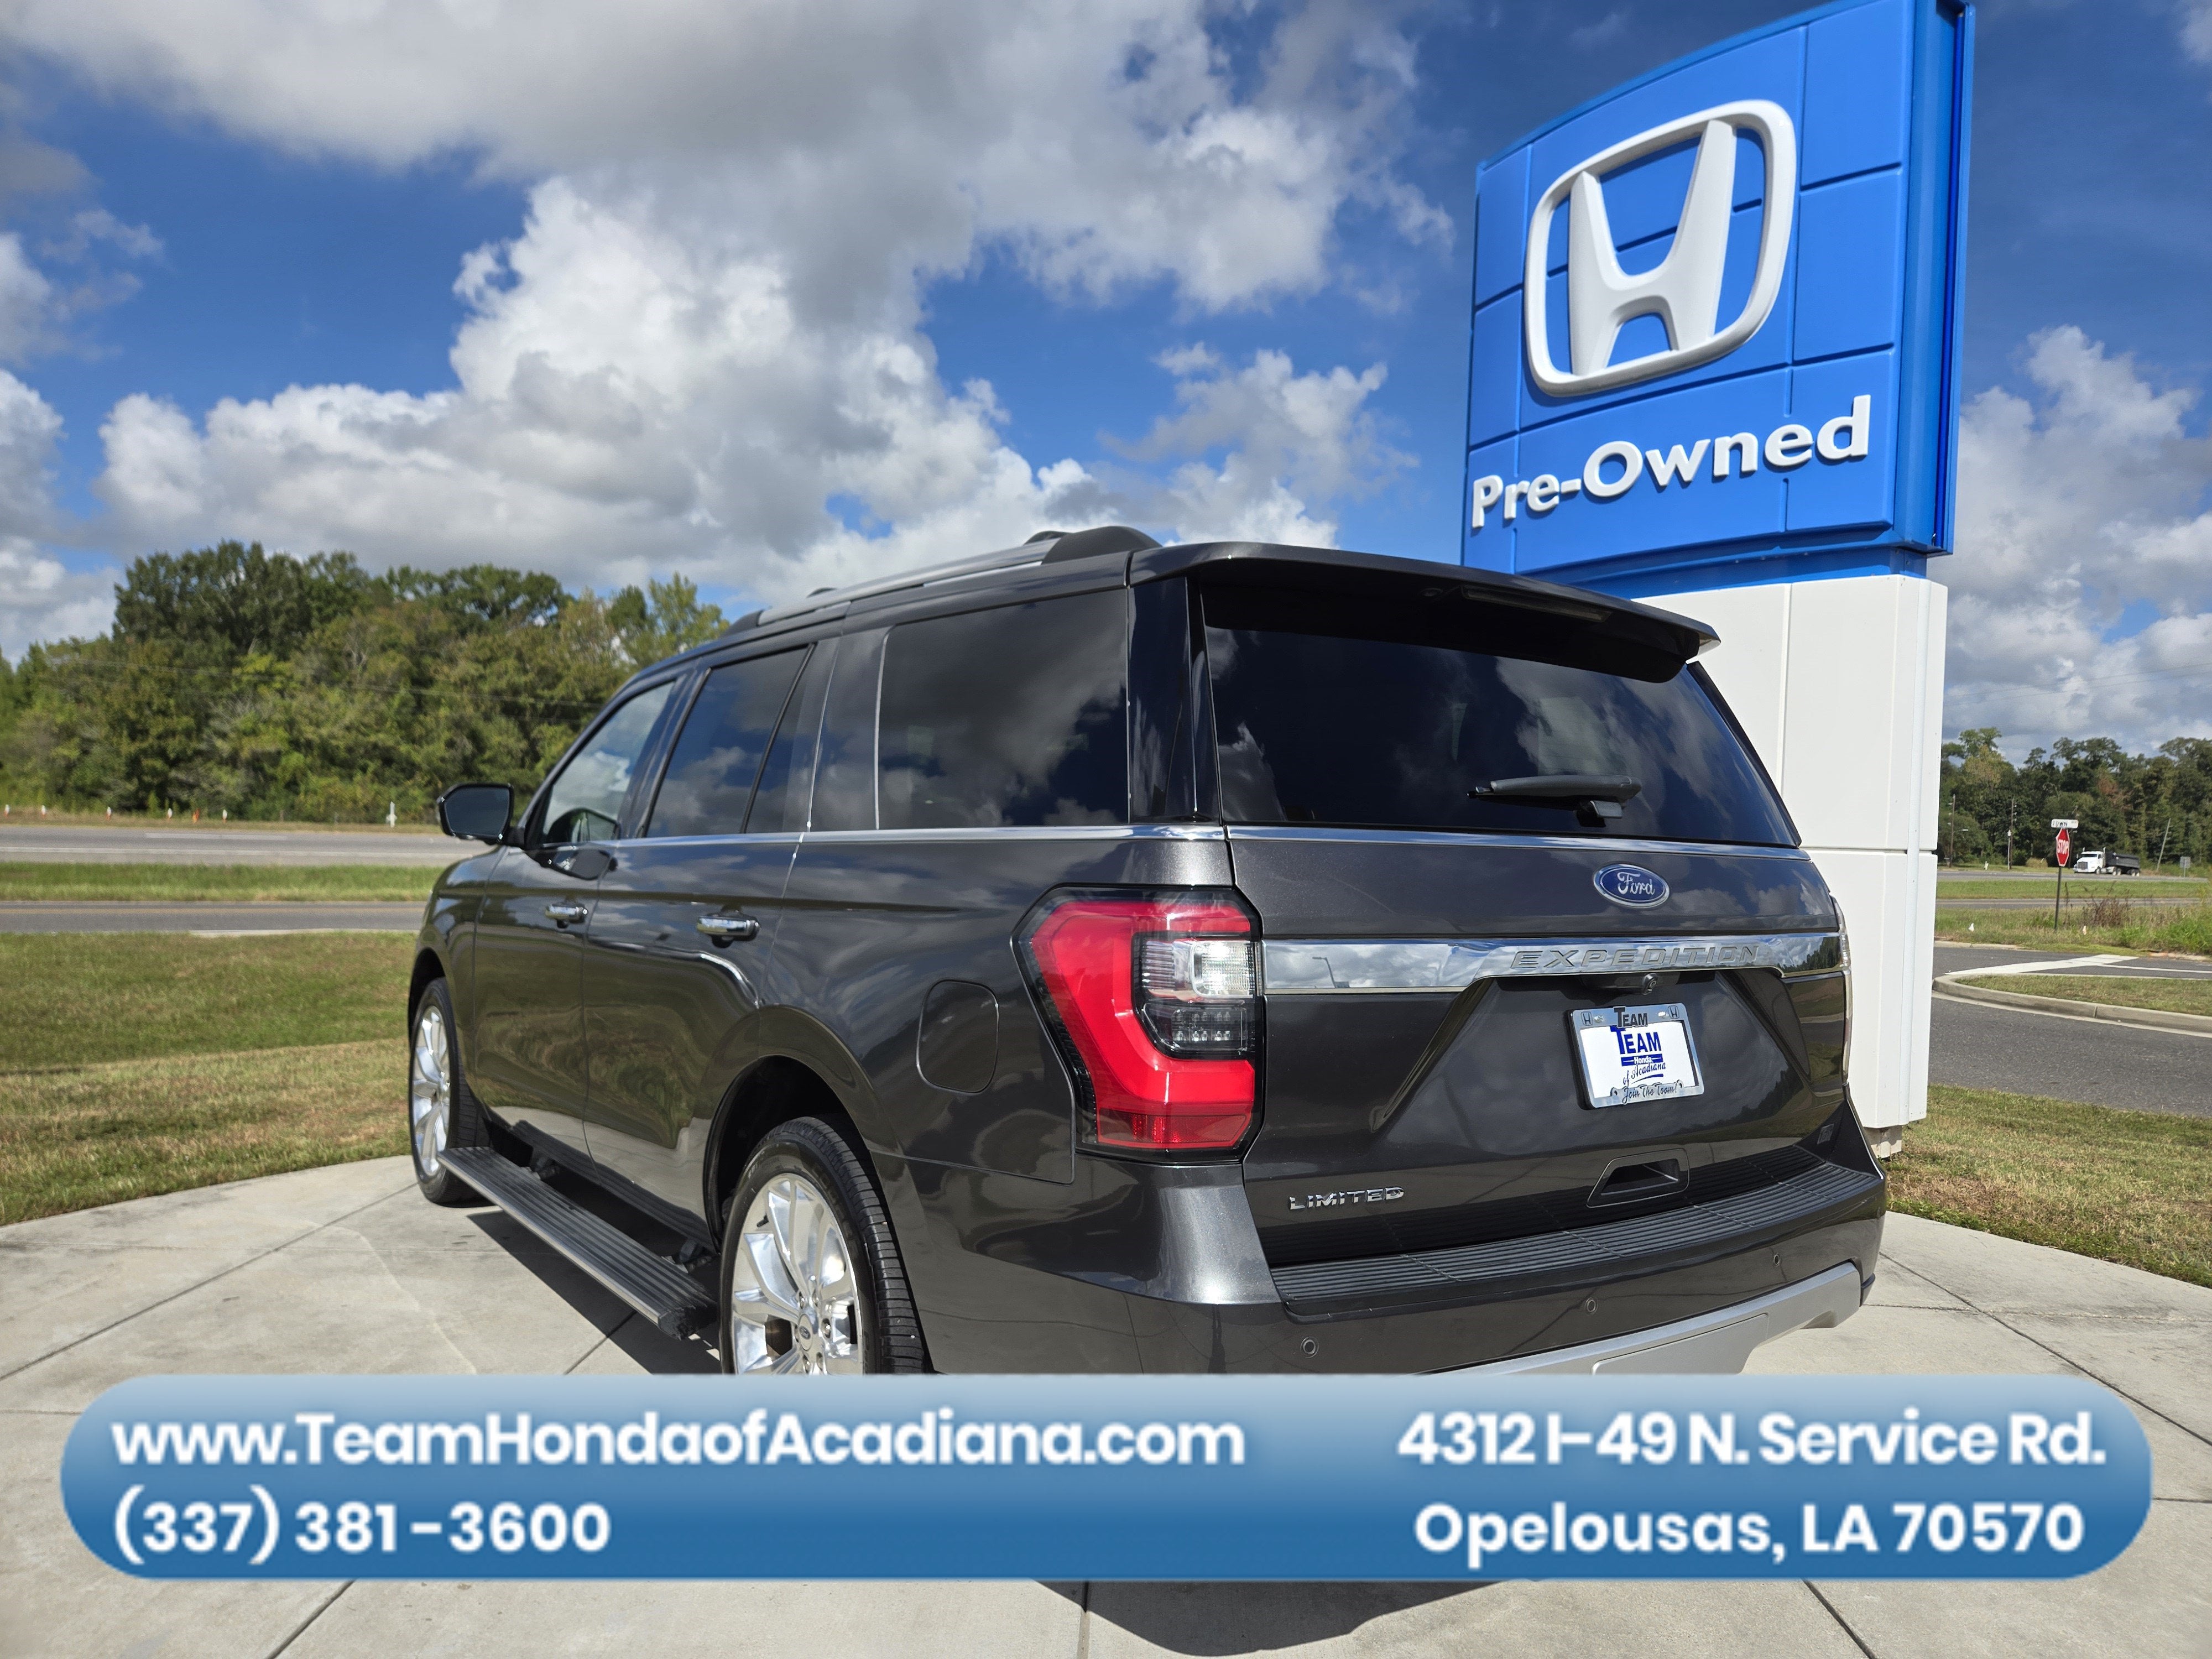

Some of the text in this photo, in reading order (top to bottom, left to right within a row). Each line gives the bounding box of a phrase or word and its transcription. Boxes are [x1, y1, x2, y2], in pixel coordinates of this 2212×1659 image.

[1472, 394, 1871, 529] Pre-Owned
[2057, 839, 2069, 855] STOP
[1617, 872, 1655, 895] Ford
[1510, 946, 1759, 969] EXPEDITION
[1613, 1006, 1648, 1028] TEAM
[1610, 1025, 1662, 1055] TEAM
[1634, 1056, 1652, 1065] Honda
[1623, 1062, 1667, 1087] of Acadiana
[1621, 1087, 1640, 1104] Join
[1640, 1084, 1655, 1098] The
[1288, 1187, 1404, 1210] LIMITED
